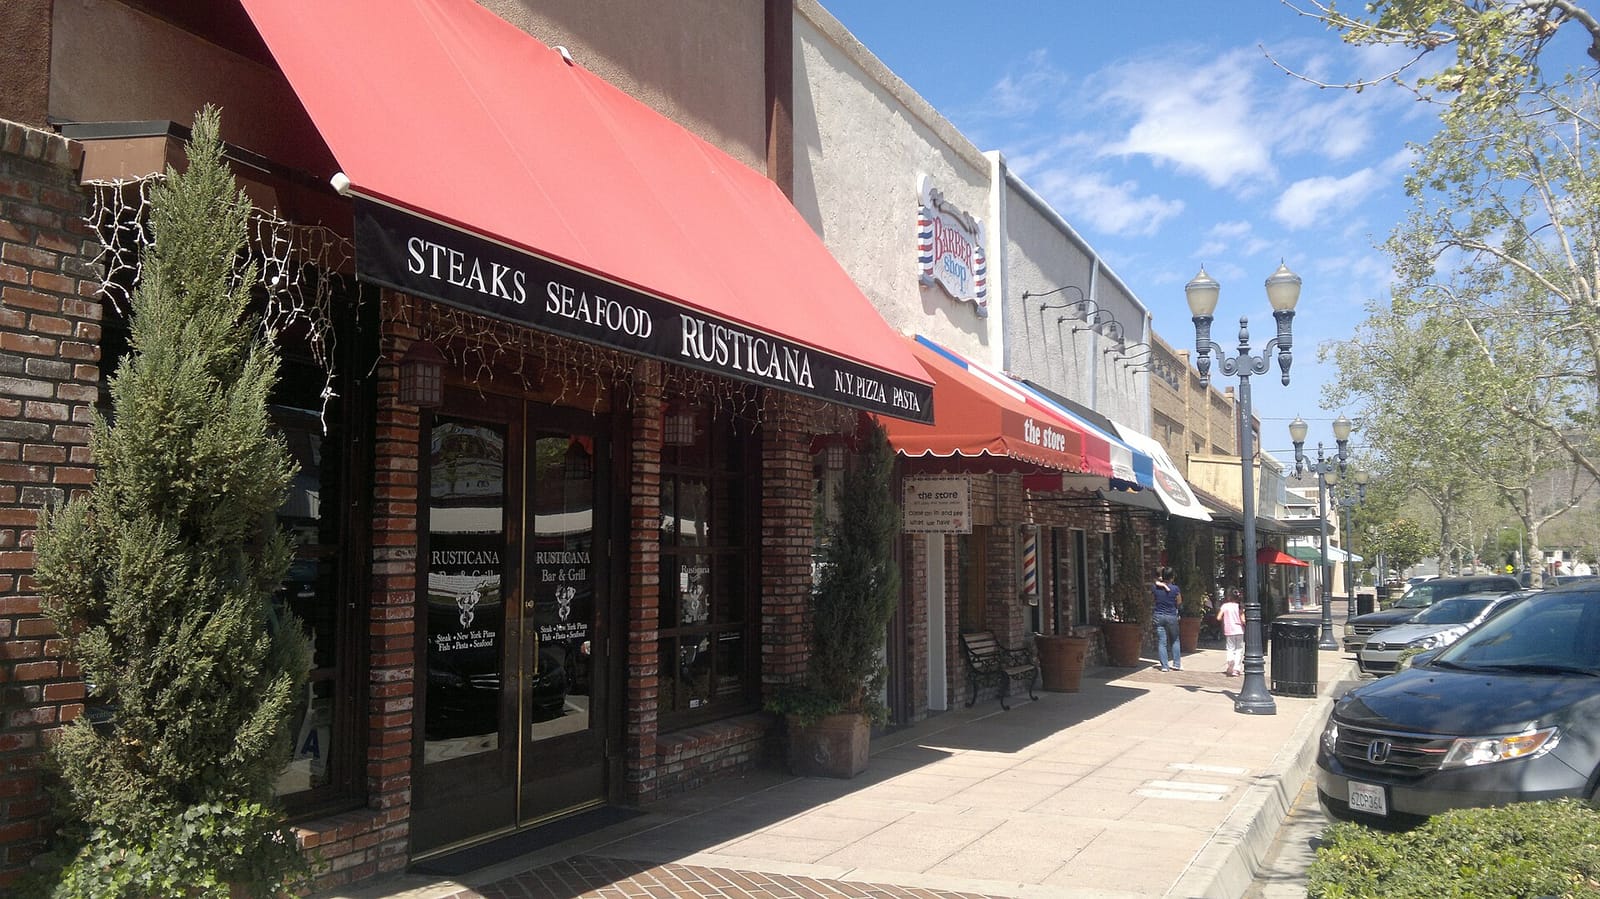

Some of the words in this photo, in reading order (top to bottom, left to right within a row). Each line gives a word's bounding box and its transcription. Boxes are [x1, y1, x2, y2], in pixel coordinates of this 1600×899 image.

[932, 216, 974, 276] BARBER
[944, 254, 967, 292] shop
[407, 236, 527, 304] STEAKS
[546, 281, 652, 338] SEAFOOD
[679, 313, 815, 389] RUSTICANA
[856, 378, 887, 404] PIZZA
[892, 386, 921, 412] PASTA
[1024, 418, 1040, 446] the
[1043, 426, 1066, 452] store
[918, 491, 933, 499] the
[935, 491, 958, 499] store
[432, 551, 500, 565] RUSTICANA
[536, 551, 591, 564] RUSTICANA
[542, 569, 557, 582] Bar
[558, 568, 566, 581] &
[568, 568, 586, 581] Grill
[437, 633, 452, 642] Steak
[456, 632, 469, 641] New
[469, 630, 482, 639] York
[483, 630, 496, 638] Pizza
[438, 642, 451, 652] Fish
[455, 641, 469, 650] Pasta
[473, 638, 493, 648] Seafood
[301, 729, 320, 759] A
